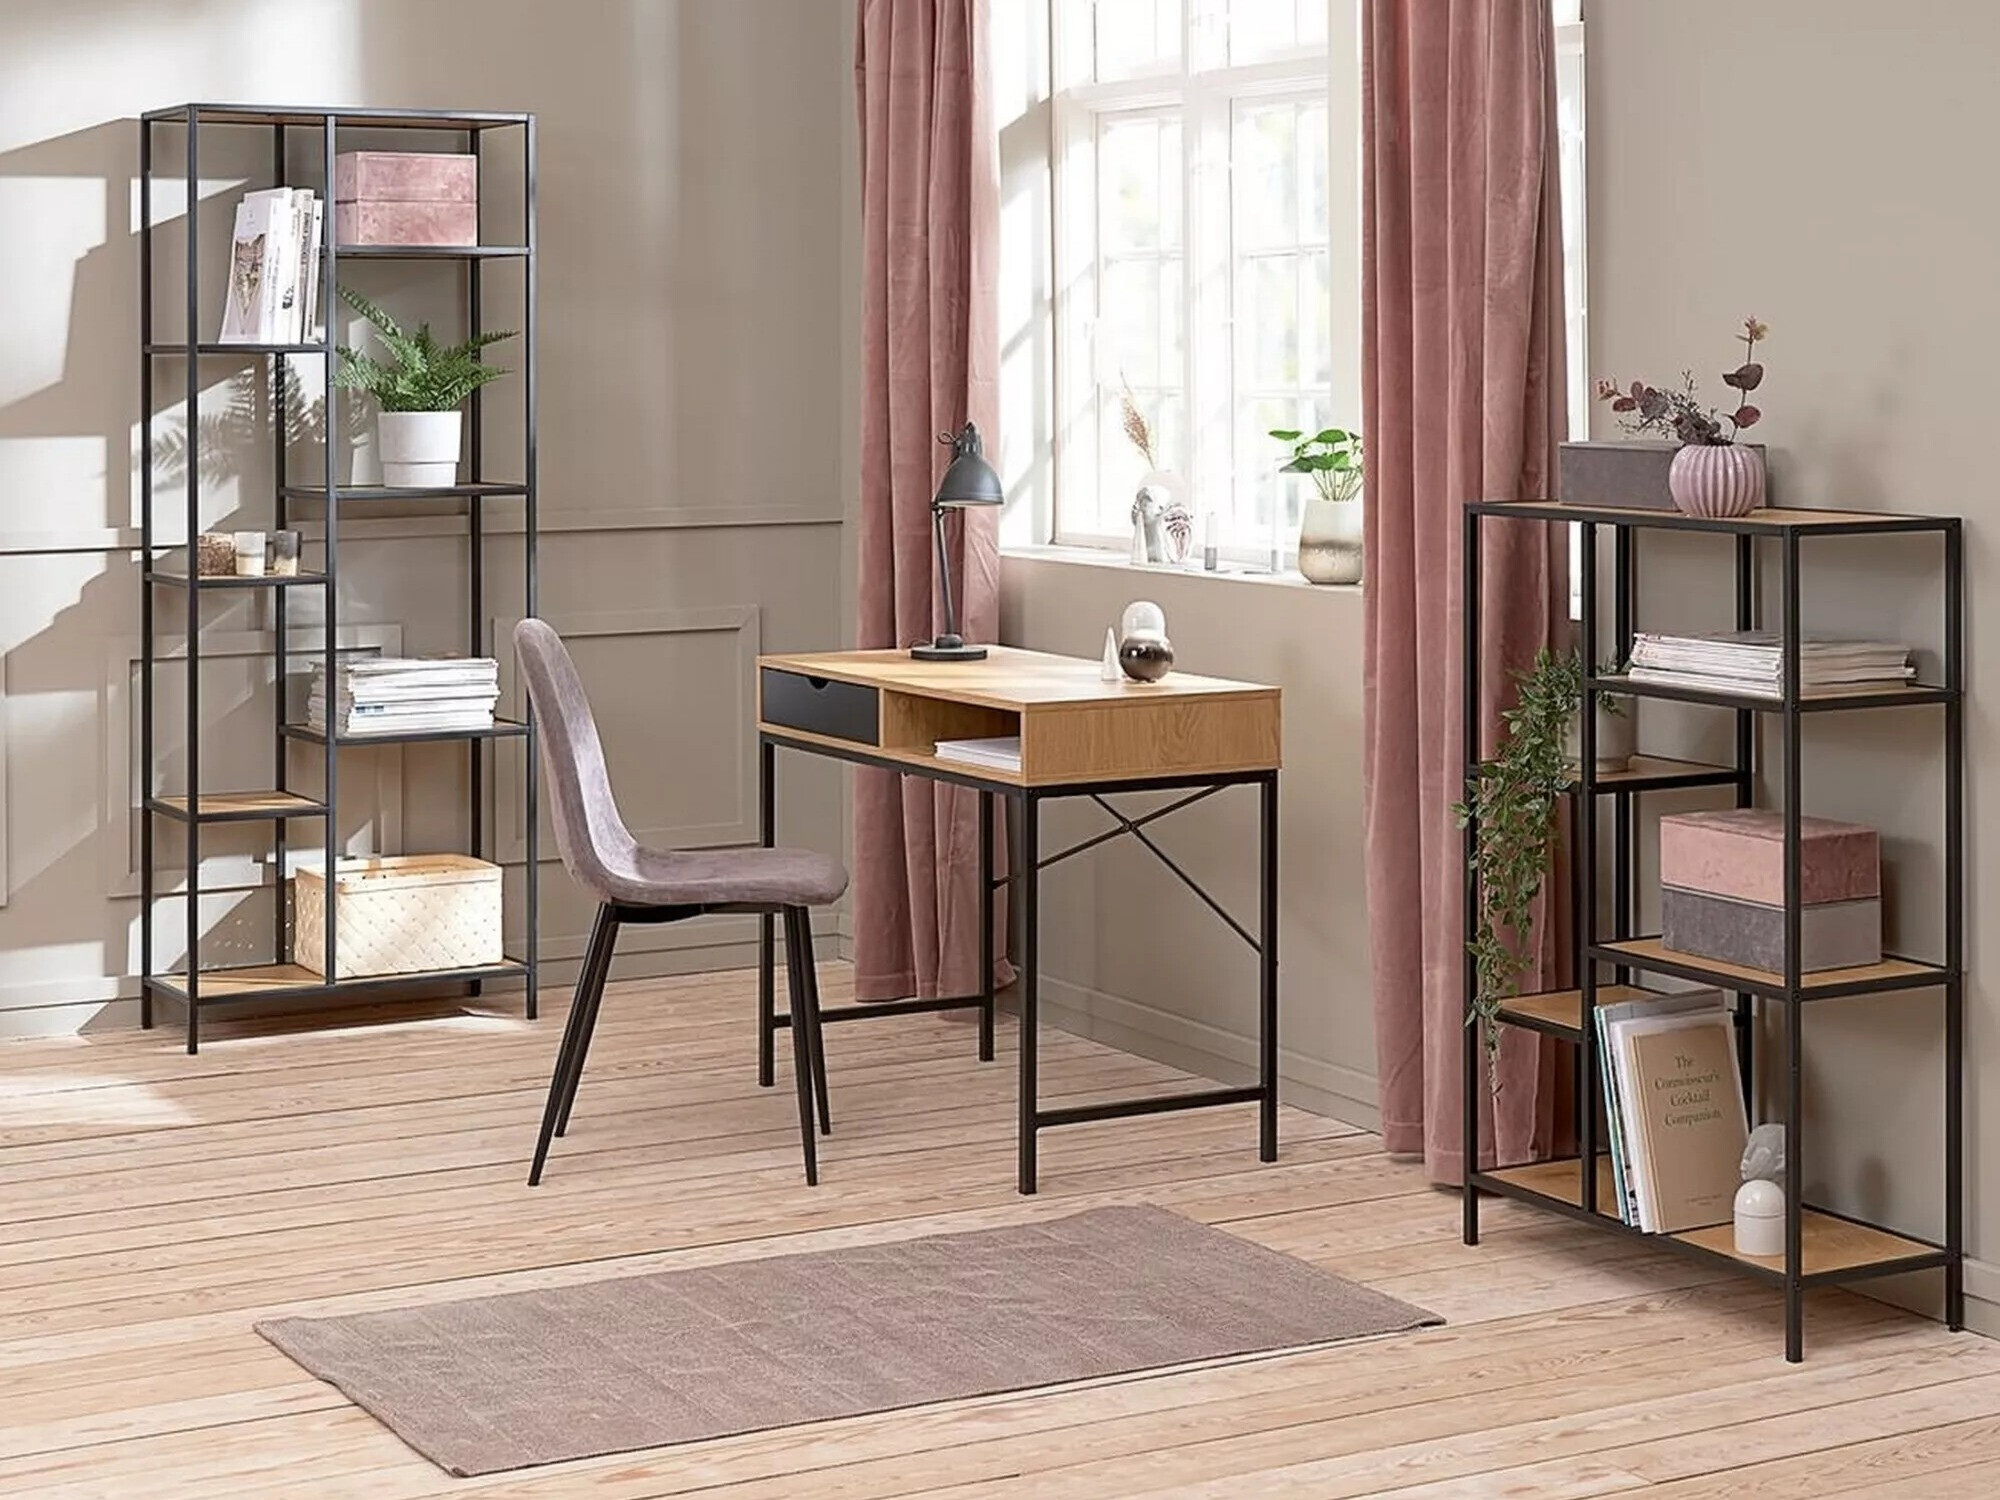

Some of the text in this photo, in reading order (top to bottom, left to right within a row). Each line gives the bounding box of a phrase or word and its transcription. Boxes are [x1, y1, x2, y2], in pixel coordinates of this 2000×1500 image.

[1674, 1054, 1695, 1068] The
[1654, 1069, 1720, 1090] Connoisseur's
[1670, 1088, 1711, 1107] Cocktail
